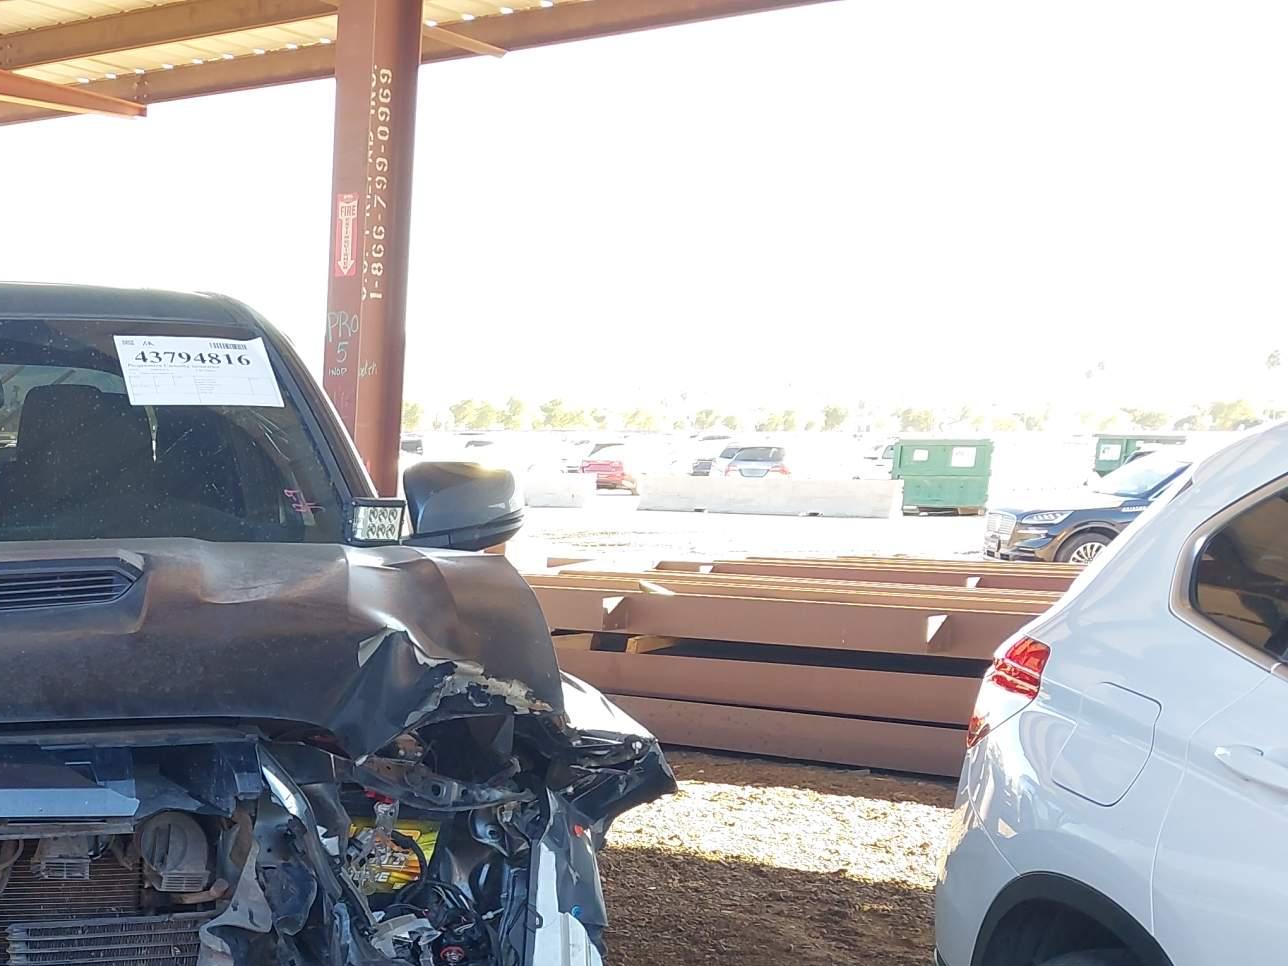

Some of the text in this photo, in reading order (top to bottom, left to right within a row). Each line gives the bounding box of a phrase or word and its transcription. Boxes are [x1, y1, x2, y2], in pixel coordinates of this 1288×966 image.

[370, 68, 393, 300] 1-866-799-0969
[340, 205, 356, 217] FIRE
[134, 350, 251, 367] 43794816
[336, 341, 349, 363] 5
